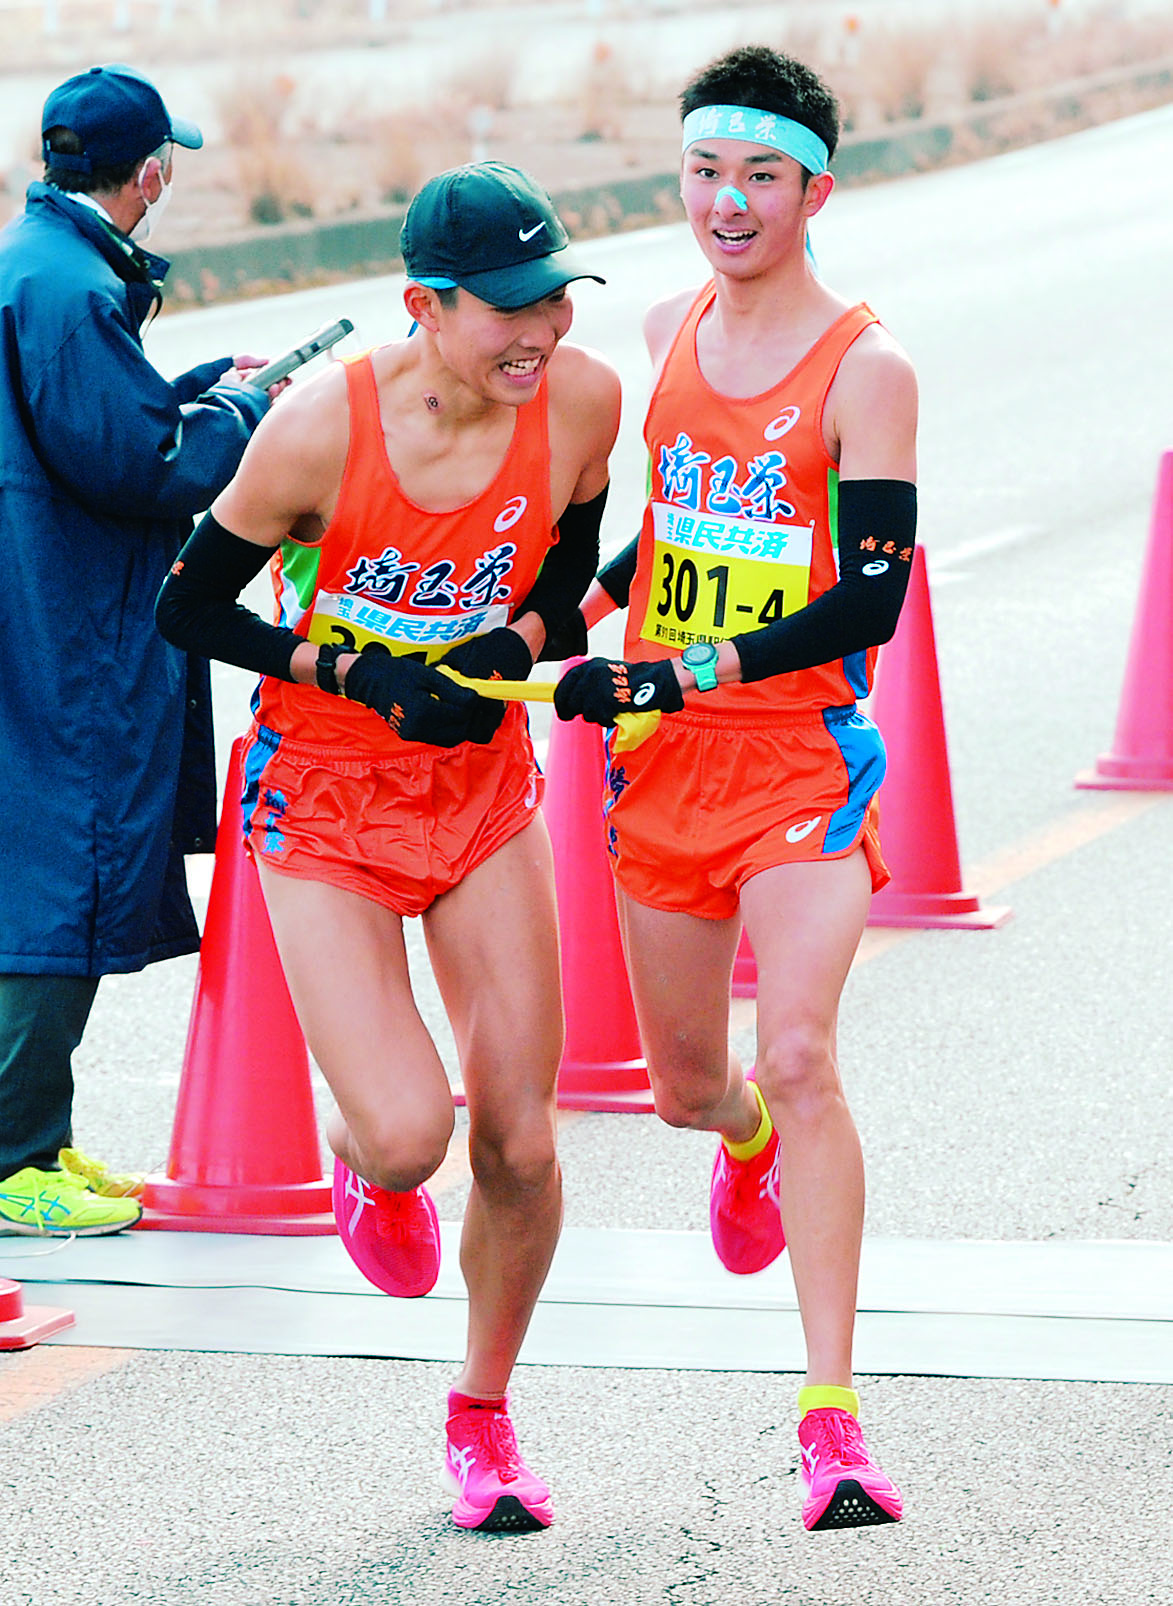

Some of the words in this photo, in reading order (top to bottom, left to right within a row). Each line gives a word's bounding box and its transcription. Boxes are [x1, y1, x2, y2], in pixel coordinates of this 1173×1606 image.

[658, 432, 796, 522] 埼玉栄
[674, 517, 789, 559] 県民共済
[343, 542, 517, 609] 埼玉栄
[657, 552, 784, 628] 301-4
[353, 605, 489, 642] 県民共済
